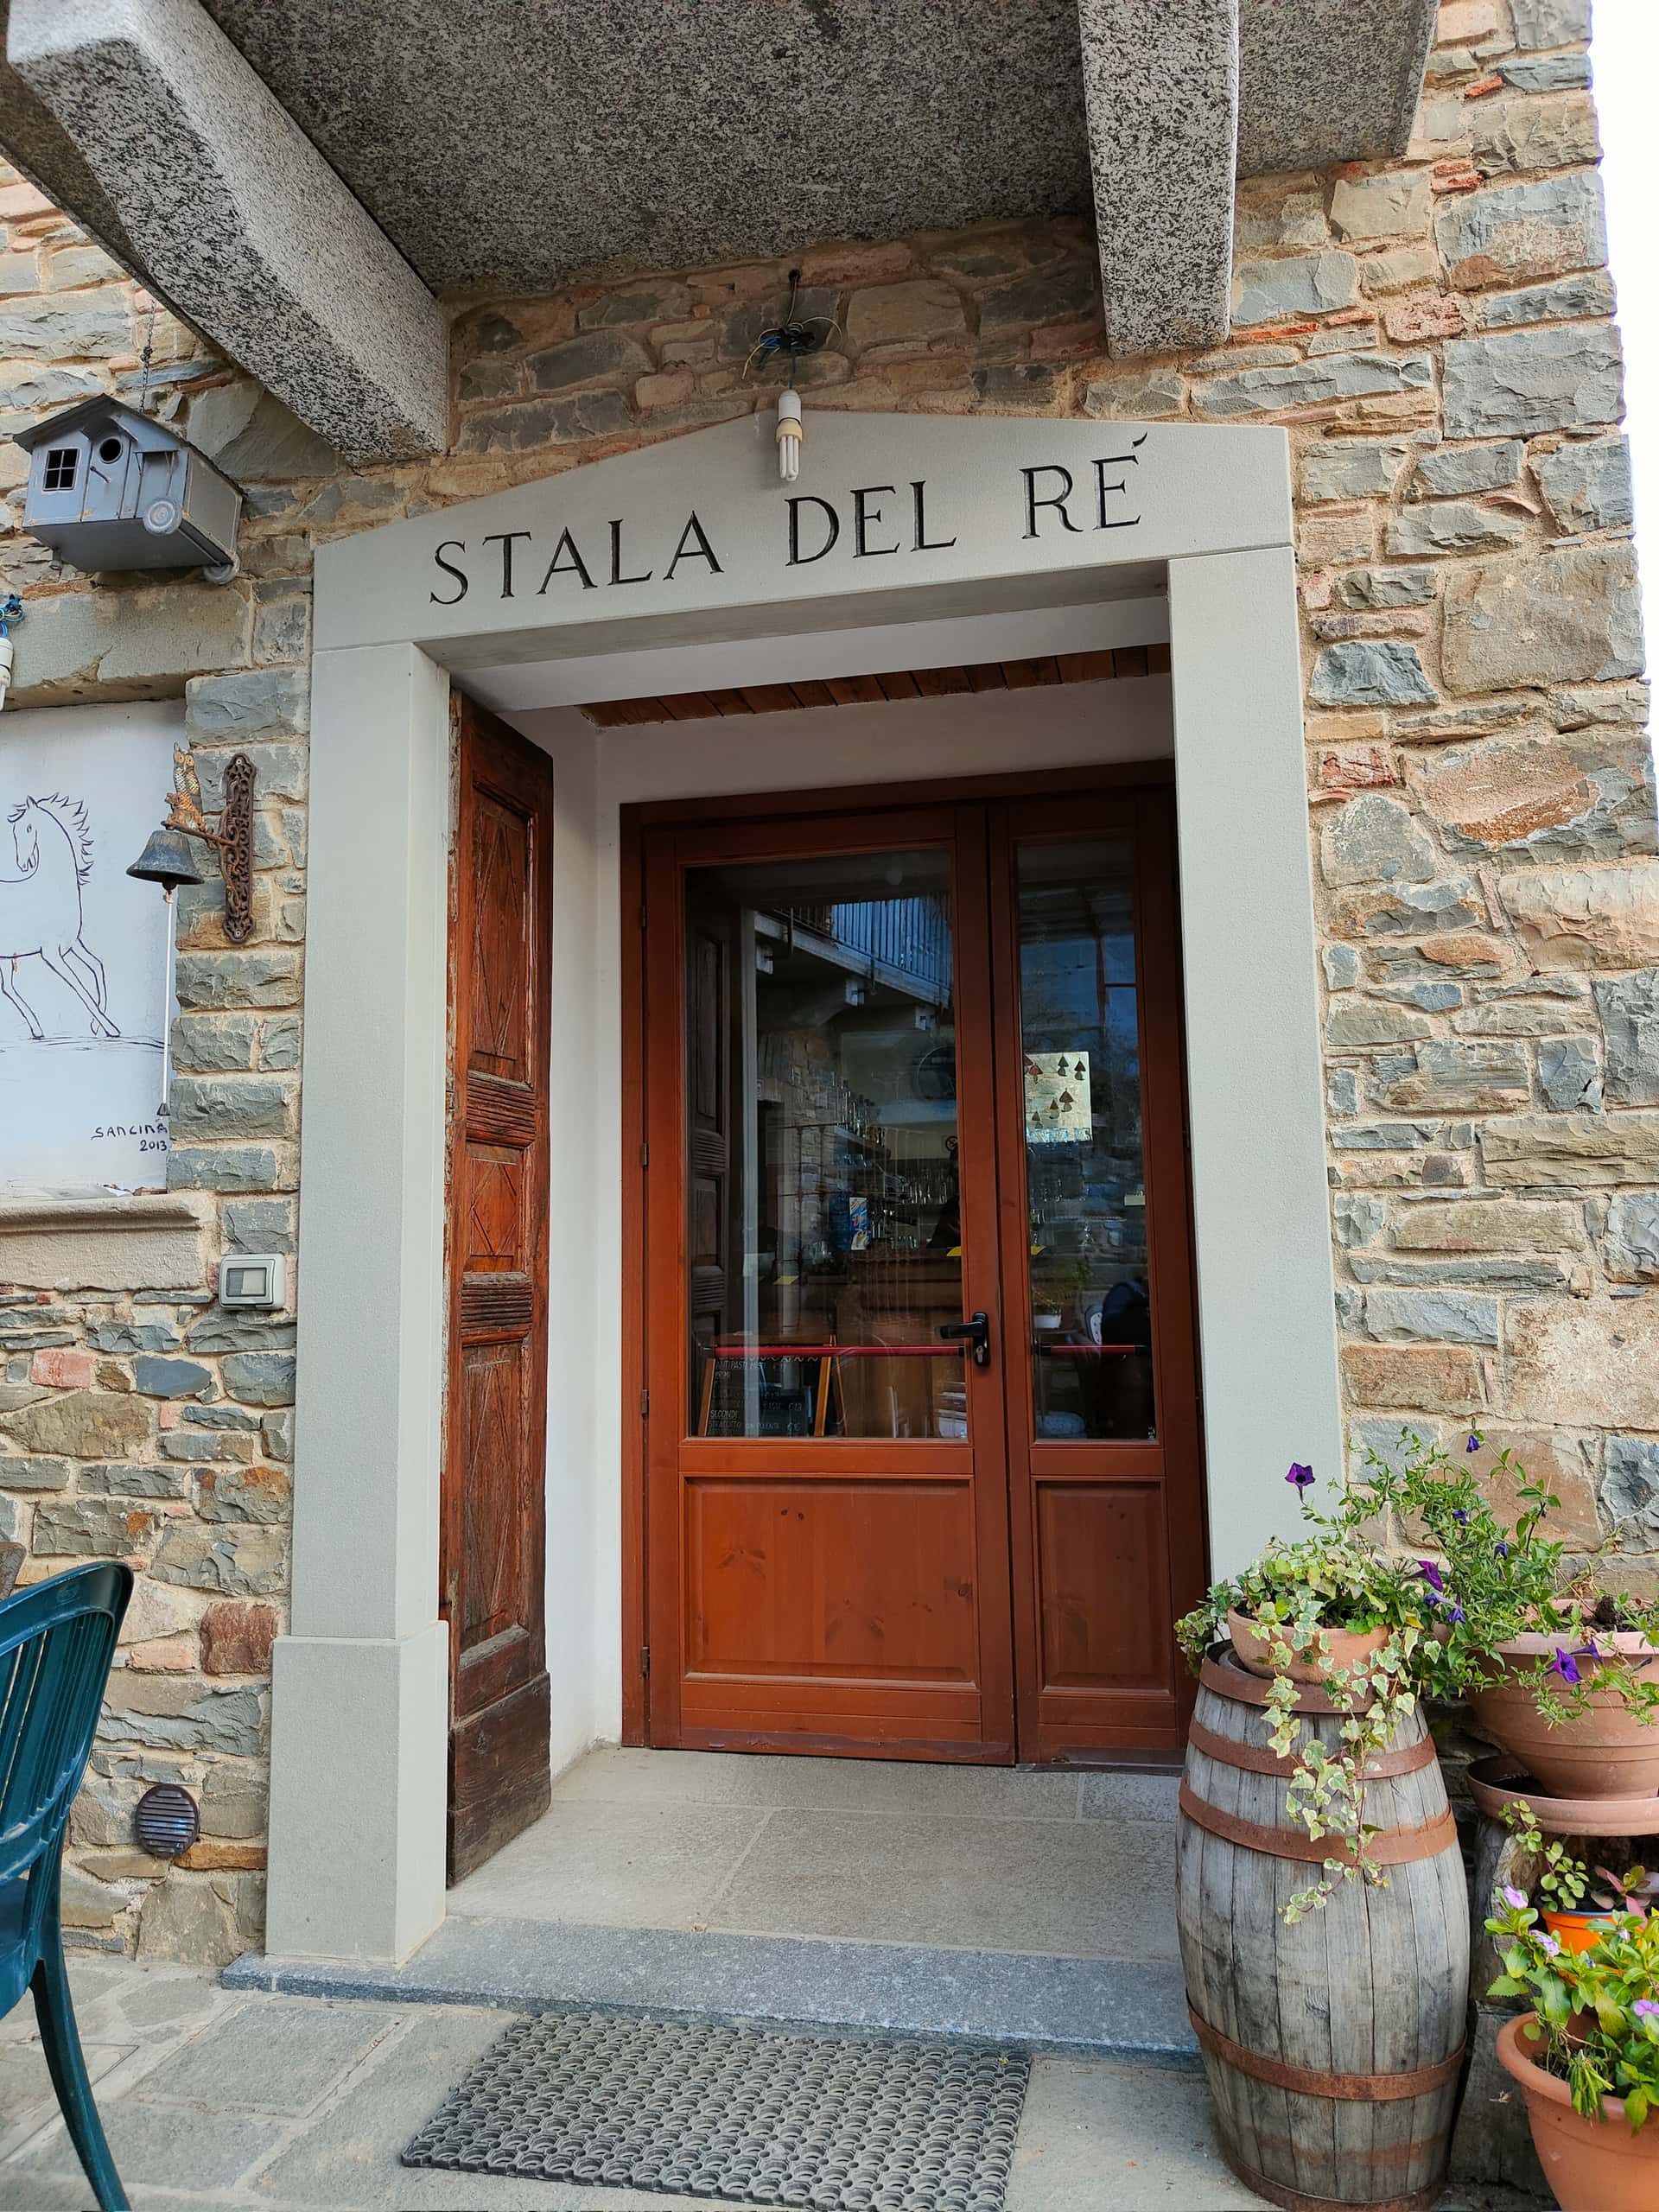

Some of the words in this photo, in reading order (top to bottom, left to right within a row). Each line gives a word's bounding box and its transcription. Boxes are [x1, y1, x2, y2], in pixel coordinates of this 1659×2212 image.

[430, 510, 724, 605] STALA
[785, 480, 957, 567] DEL
[139, 1139, 168, 1152] 2013
